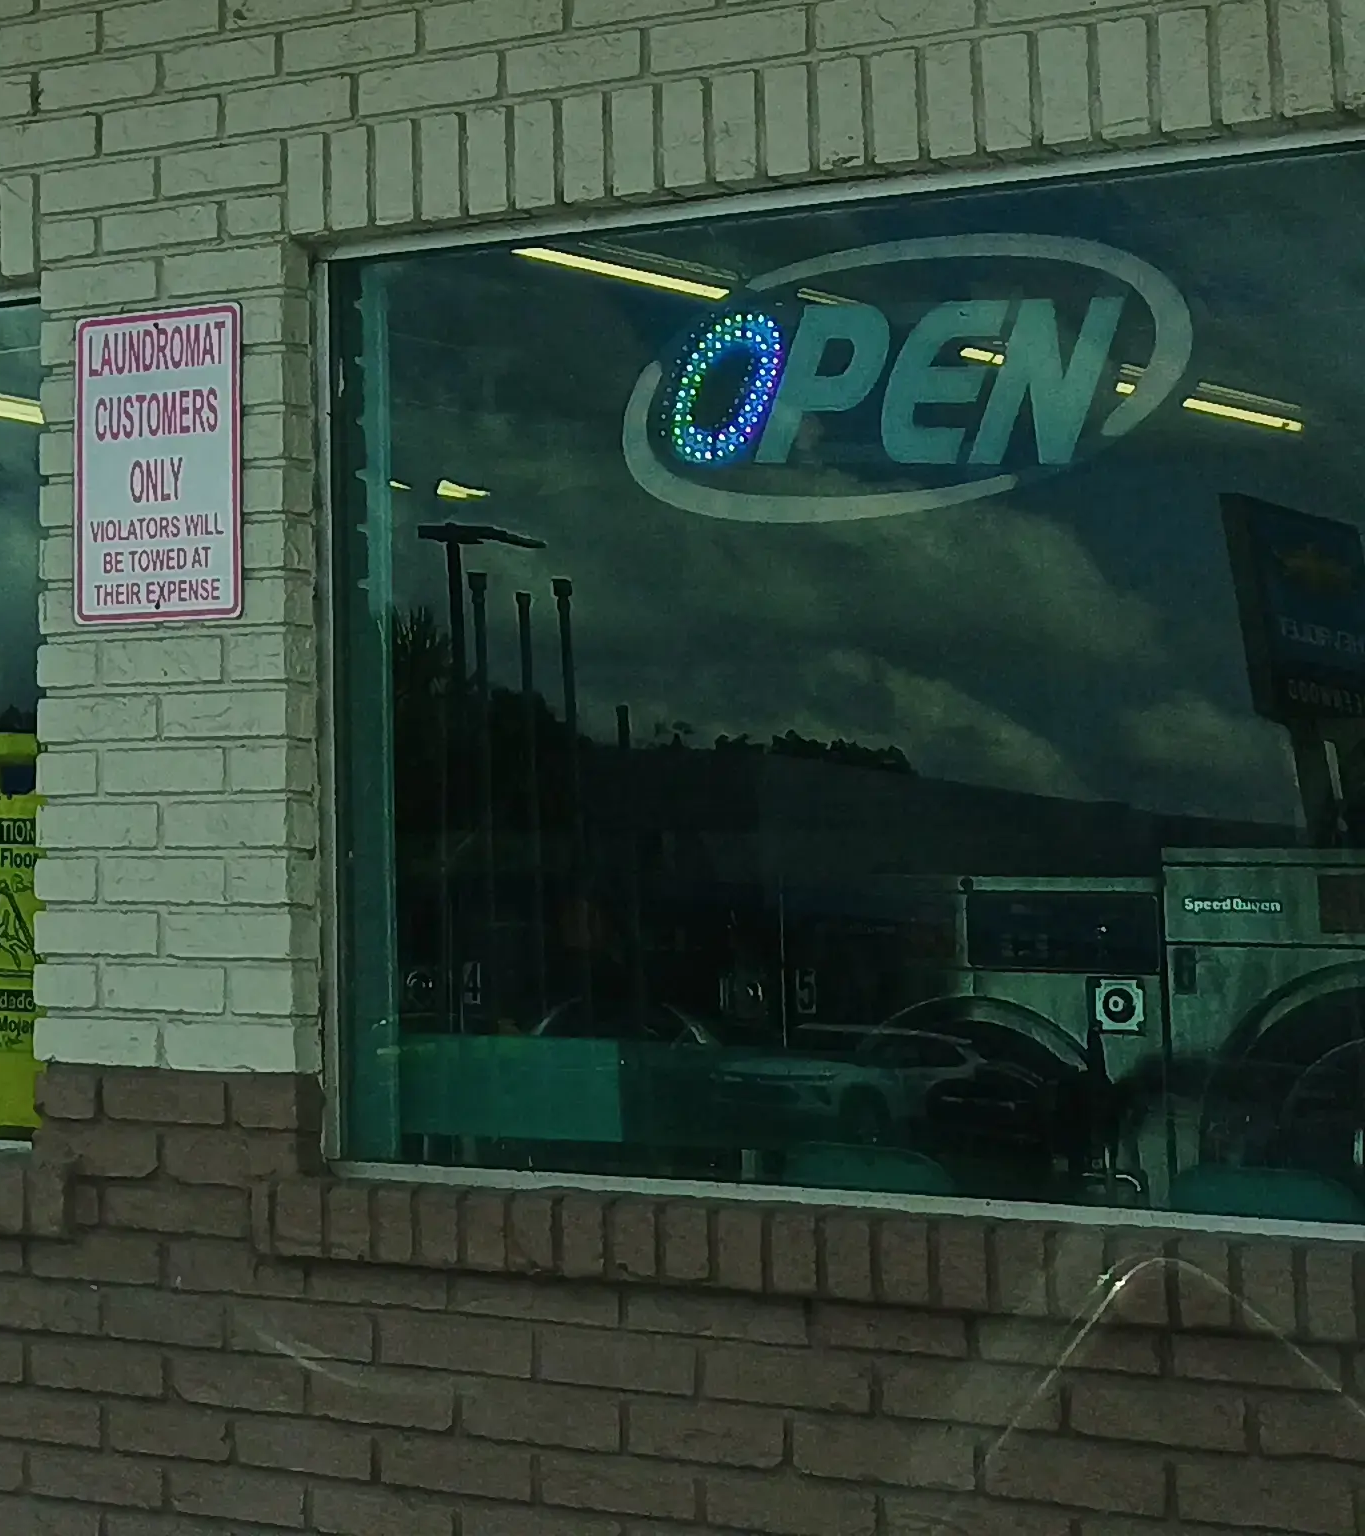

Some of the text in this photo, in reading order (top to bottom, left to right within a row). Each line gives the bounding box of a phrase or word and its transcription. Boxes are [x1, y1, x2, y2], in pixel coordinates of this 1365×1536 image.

[88, 320, 226, 377] LAUNDROMAT
[665, 296, 1128, 465] OPEN
[95, 386, 218, 442] CUSTOMERS
[129, 456, 183, 503] ONLY
[90, 512, 225, 543] VIOLATORS WILL
[103, 546, 212, 574] BE TOWED AT
[94, 578, 221, 606] THEIR EXPENSE
[0, 846, 38, 869] Floor
